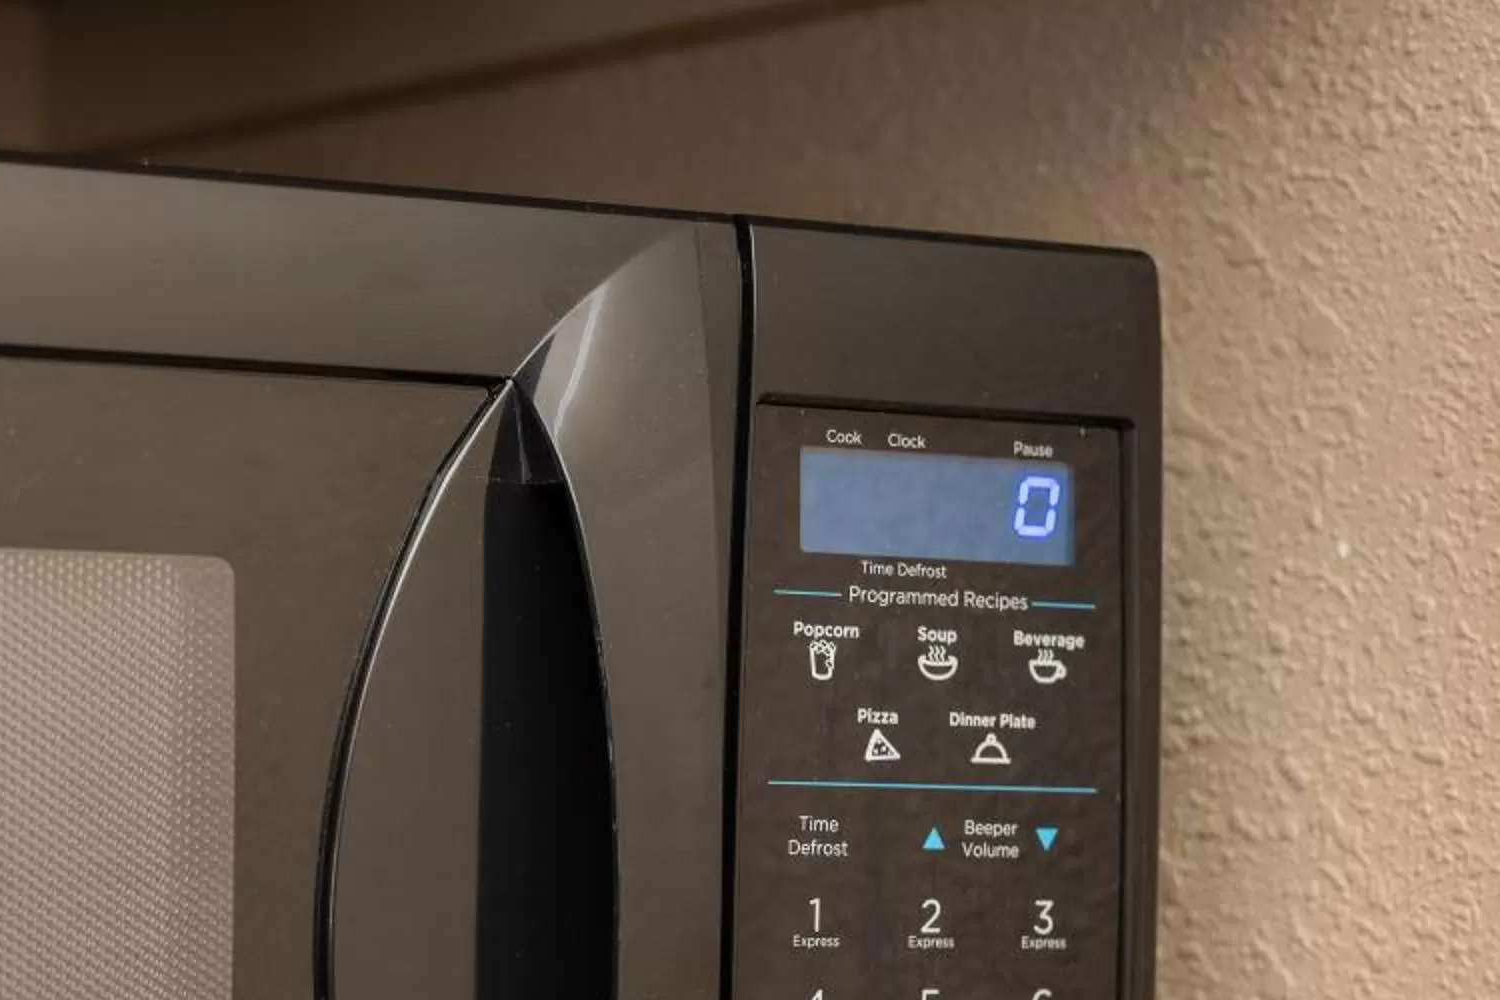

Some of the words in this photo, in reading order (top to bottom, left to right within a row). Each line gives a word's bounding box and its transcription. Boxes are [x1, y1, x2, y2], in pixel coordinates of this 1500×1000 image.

[826, 429, 862, 445] Cook
[888, 433, 926, 449] Clock
[1014, 441, 1053, 458] Pause
[1014, 476, 1060, 537] 0
[861, 560, 893, 577] Time
[897, 562, 948, 580] Defrost
[849, 586, 959, 609] Programmed
[964, 592, 1029, 611] Recipes
[793, 621, 860, 640] Popcorn
[917, 626, 957, 644] Soup
[1014, 630, 1085, 650] Beverage
[857, 708, 898, 725] Pizza
[949, 711, 996, 729] Dinner
[1000, 713, 1036, 730] Plate
[799, 816, 839, 832] Time
[964, 820, 1018, 838] Beeper
[788, 840, 848, 857] Defrost
[962, 842, 1019, 859] Volume
[809, 898, 821, 933] 1
[920, 899, 941, 934] 2
[1033, 900, 1054, 935] 3
[793, 935, 840, 950] Express
[907, 935, 955, 950] Express
[1021, 936, 1066, 951] Express
